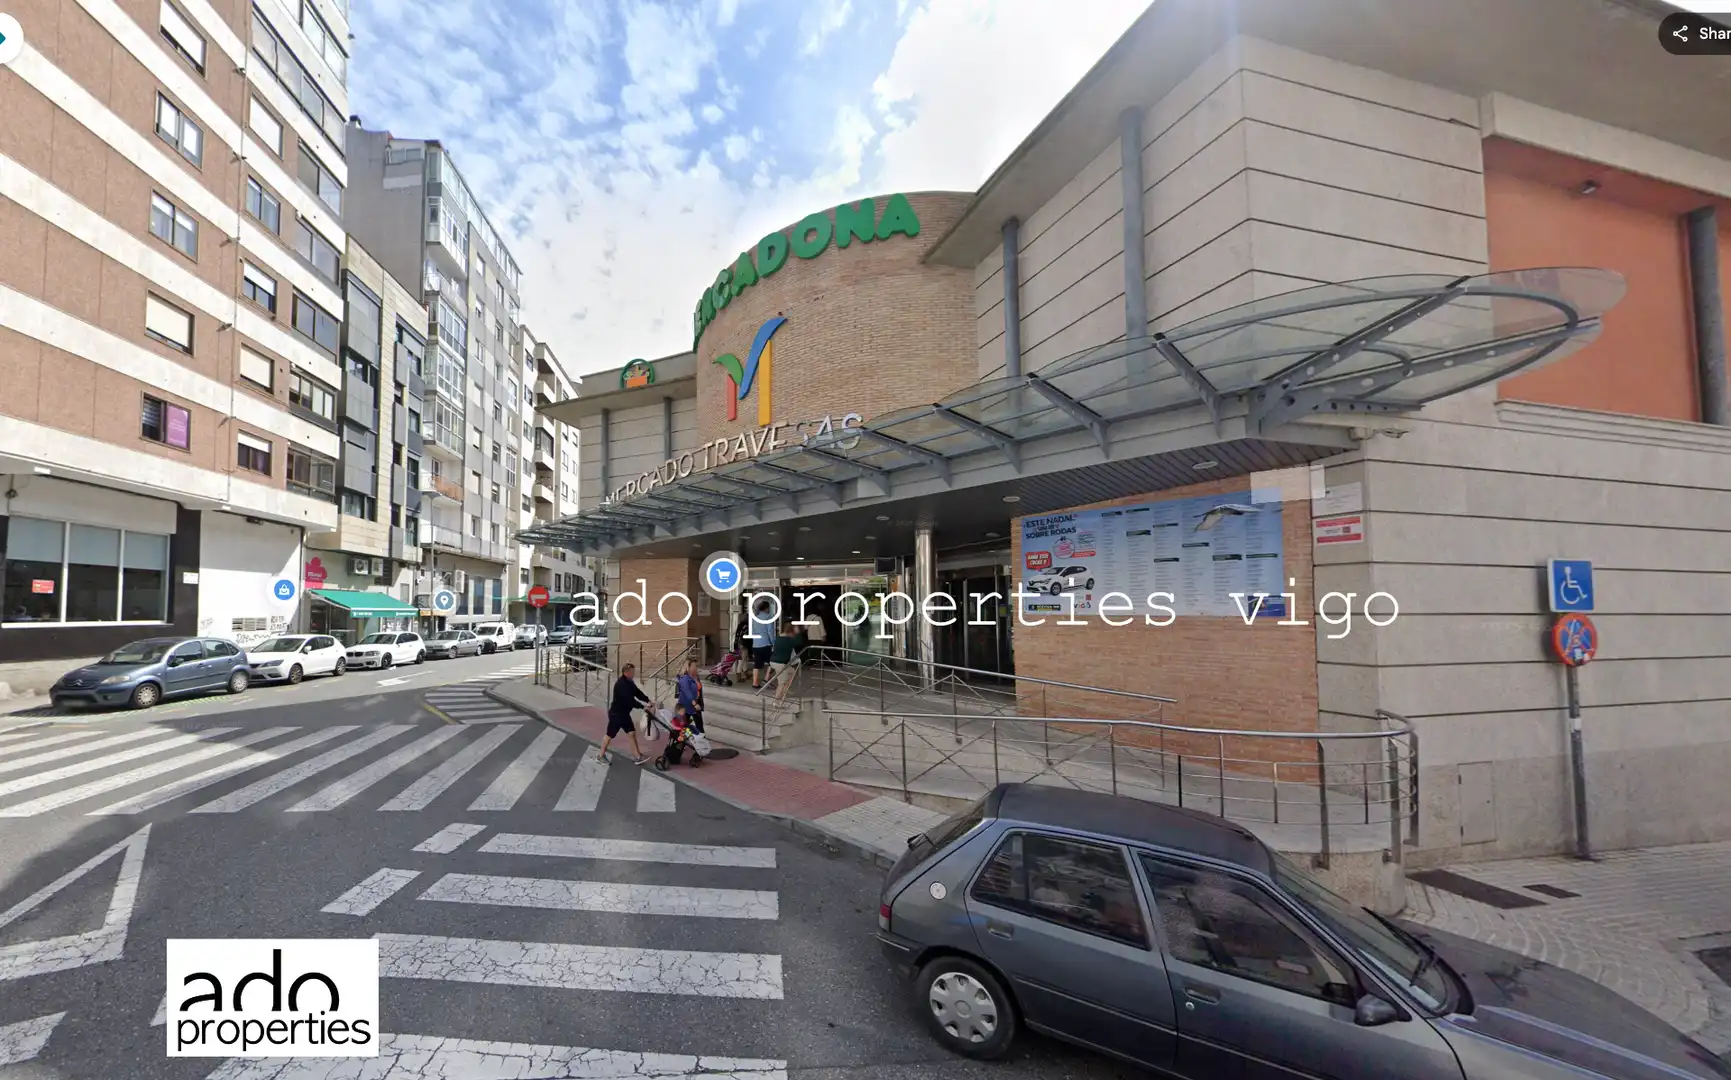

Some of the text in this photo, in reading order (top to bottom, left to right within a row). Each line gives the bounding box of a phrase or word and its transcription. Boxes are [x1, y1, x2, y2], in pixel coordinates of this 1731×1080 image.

[693, 192, 921, 353] ERCADONA
[604, 412, 865, 505] MERCADO TRAVESAS
